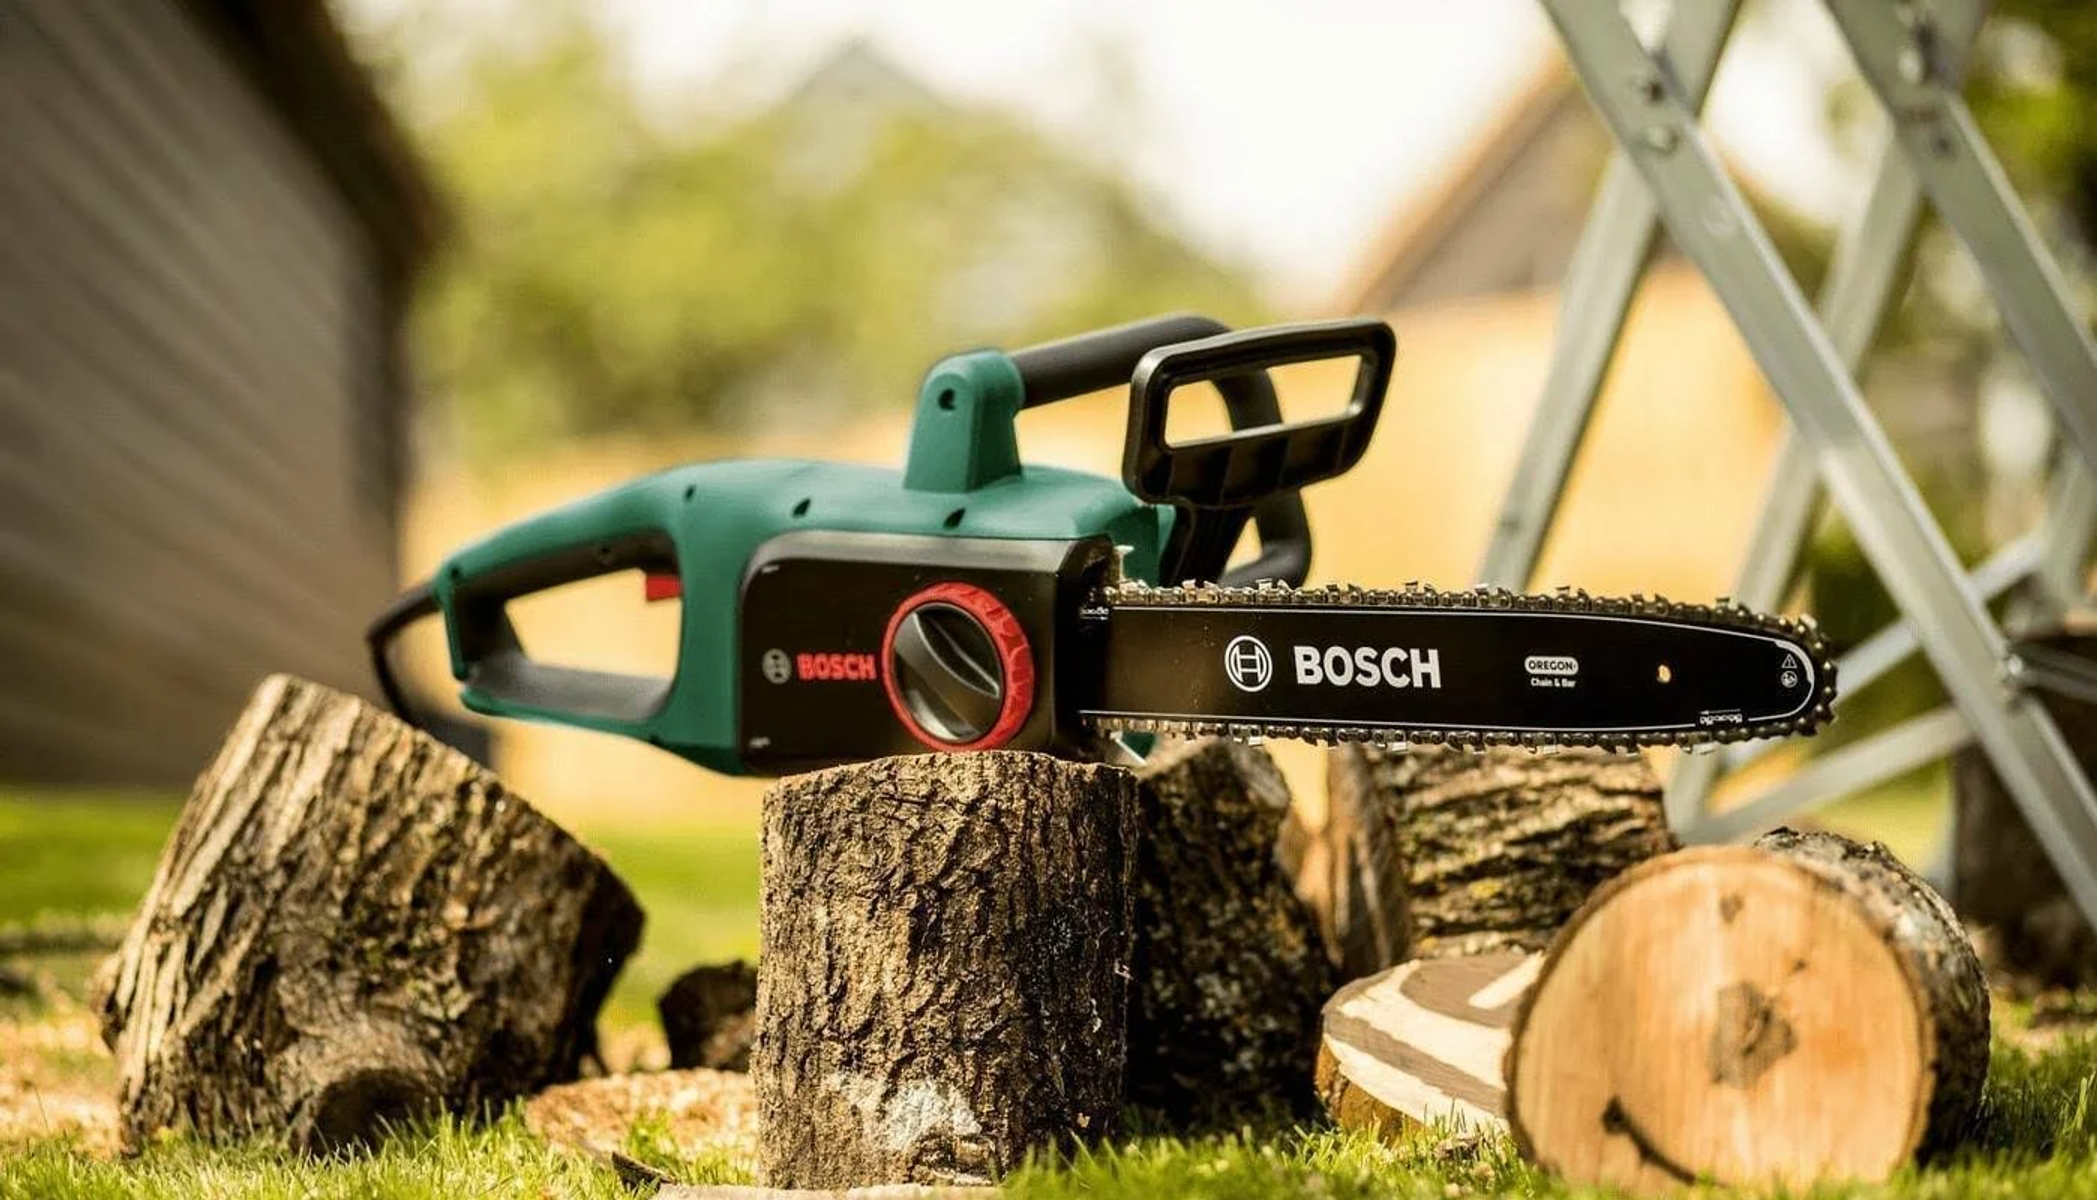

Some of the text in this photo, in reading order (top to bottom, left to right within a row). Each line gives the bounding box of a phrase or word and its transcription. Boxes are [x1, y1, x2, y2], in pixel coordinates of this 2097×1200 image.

[797, 653, 876, 680] BOSCH
[1293, 645, 1441, 688] BOSCH
[1528, 660, 1574, 671] OREGON
